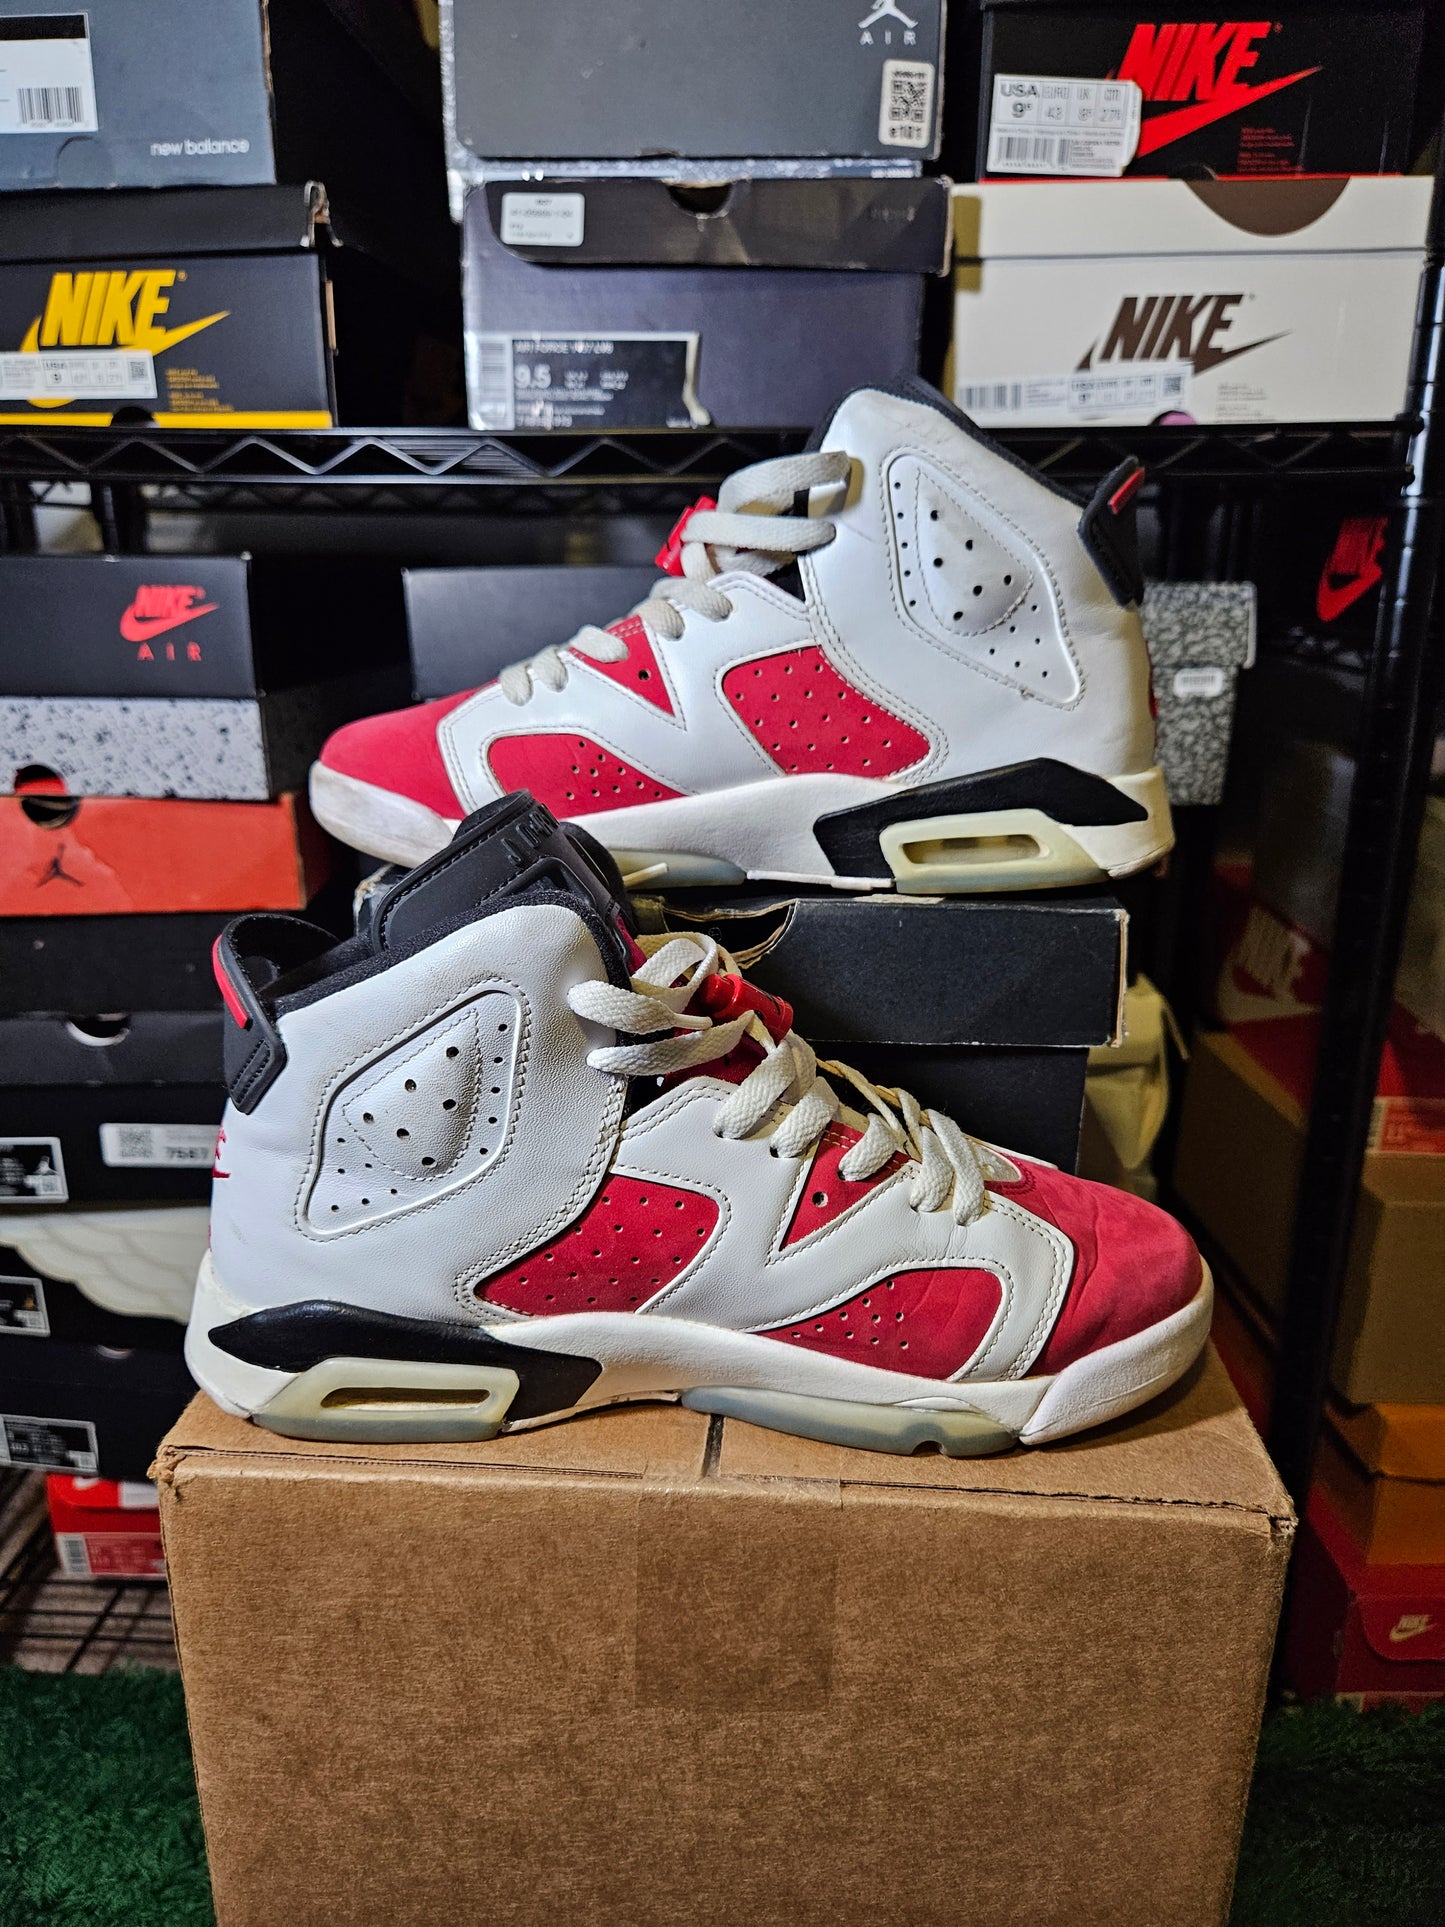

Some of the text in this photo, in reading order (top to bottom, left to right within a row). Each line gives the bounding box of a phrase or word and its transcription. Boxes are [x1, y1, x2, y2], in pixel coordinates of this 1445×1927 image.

[860, 30, 917, 46] AIR
[1117, 22, 1271, 101] NIKE
[1001, 83, 1040, 98] USA
[150, 138, 250, 156] new balance
[40, 270, 176, 346] NIKE
[1100, 294, 1244, 360] NIKE
[535, 341, 568, 354] FORCE
[514, 364, 551, 388] 9.5
[135, 585, 197, 618] NIKE
[137, 642, 202, 661] AIR
